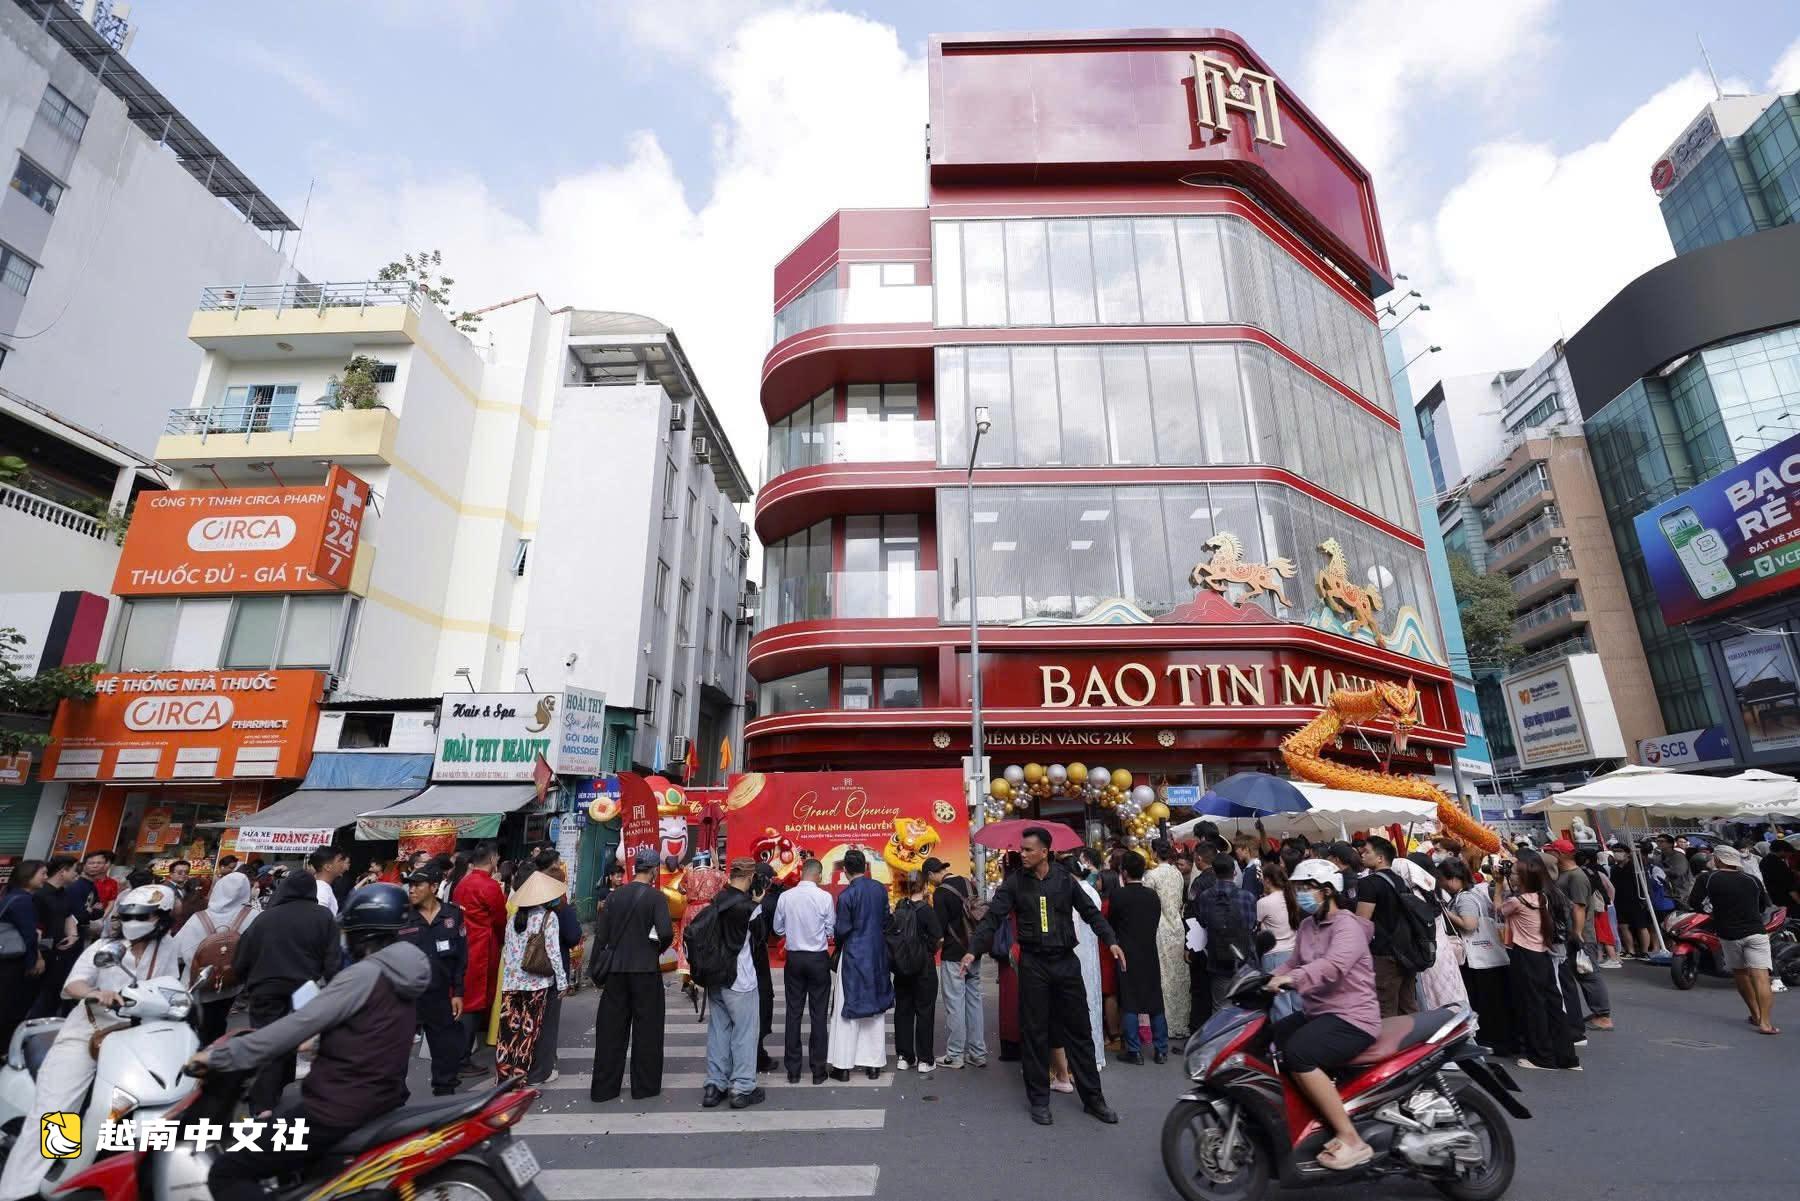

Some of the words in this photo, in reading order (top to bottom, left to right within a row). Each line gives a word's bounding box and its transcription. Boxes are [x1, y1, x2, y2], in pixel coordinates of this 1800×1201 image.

[151, 494, 185, 508] CÔNG
[190, 496, 204, 507] TY
[207, 495, 241, 507] TNHH
[245, 494, 281, 506] CIRCA
[331, 508, 358, 530] OPEN
[1736, 494, 1793, 541] RẺ
[202, 519, 281, 540] CIRCA
[325, 520, 353, 551] 24
[131, 563, 200, 585] THUỐC
[205, 562, 235, 584] ĐỦ
[254, 562, 287, 583] GIÁ
[327, 553, 342, 576] 7
[96, 677, 118, 695] HỆ
[122, 674, 178, 693] THỐNG
[181, 676, 217, 692] NHÀ
[222, 673, 278, 691] THUỐC
[1039, 662, 1157, 708] BAO
[1165, 664, 1264, 706] TIN
[132, 701, 222, 726] CIRCA
[453, 703, 481, 718] Hair
[482, 704, 490, 718] &
[493, 703, 516, 720] Spa
[566, 692, 586, 711] HOÀI
[588, 698, 604, 714] THY
[231, 720, 289, 730] PHARMACY
[442, 733, 472, 762] HOÀI
[475, 739, 500, 762] THY
[501, 738, 550, 763] BEAUTY
[1104, 732, 1134, 745] 24K
[1661, 741, 1688, 758] SCB
[562, 745, 600, 756] MASSAGE
[793, 790, 840, 840] Grand
[845, 790, 900, 826] Opening
[859, 819, 893, 830] NGUYỄN
[272, 830, 309, 844] HOÀNG
[310, 830, 331, 844] HẢI
